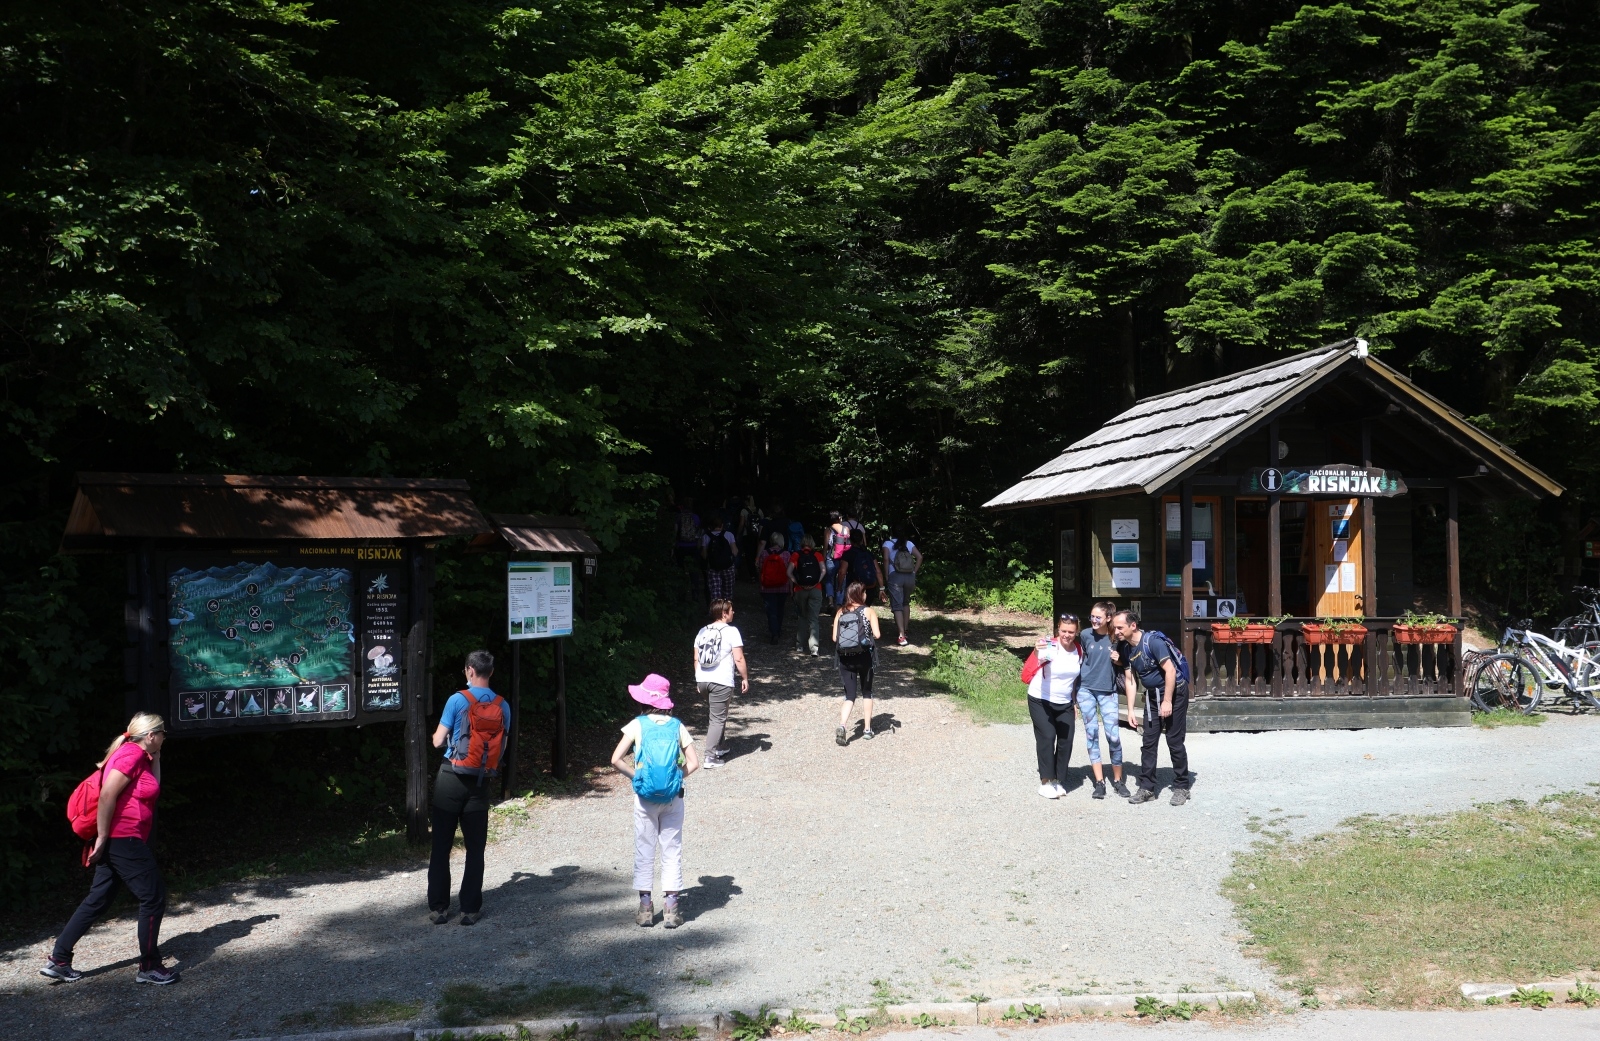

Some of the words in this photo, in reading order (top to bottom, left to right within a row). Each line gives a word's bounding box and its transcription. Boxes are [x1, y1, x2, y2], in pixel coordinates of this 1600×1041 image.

[1308, 476, 1382, 493] RISNJAK
[300, 547, 338, 555] NACIONALNI
[340, 547, 355, 555] PARK
[357, 548, 402, 560] RISNJAK
